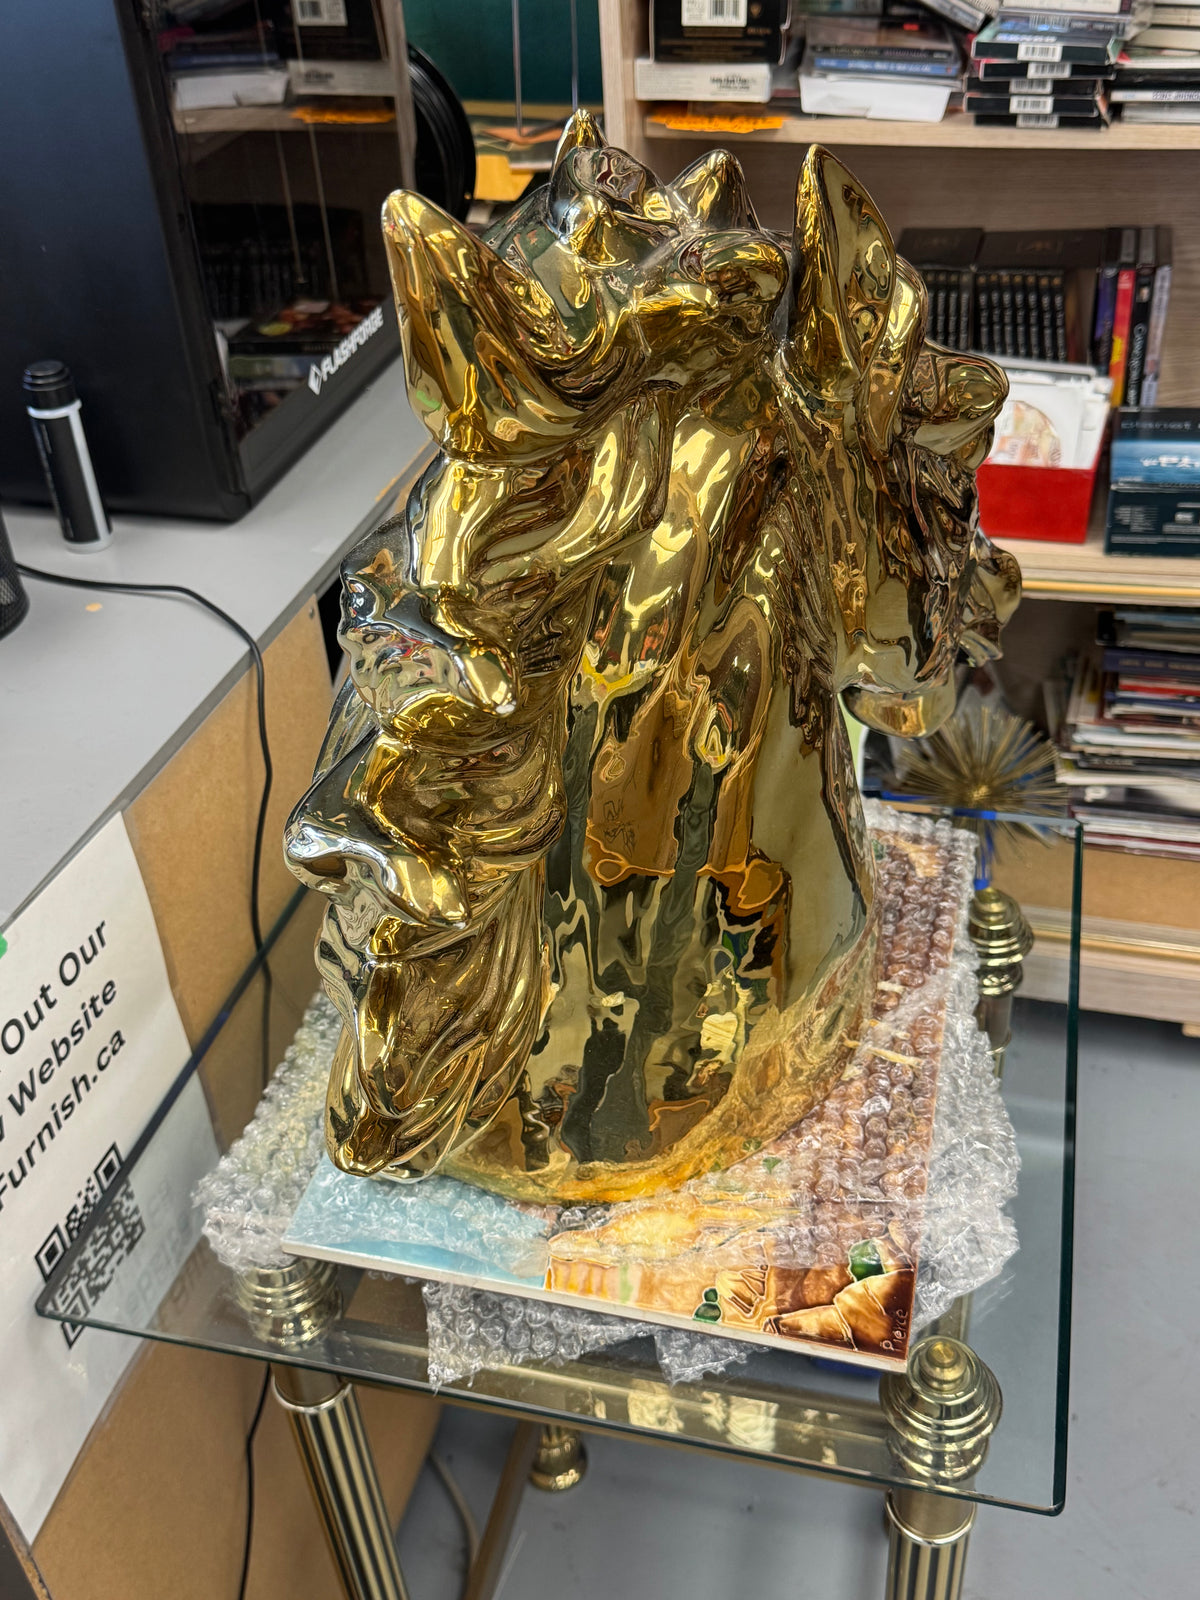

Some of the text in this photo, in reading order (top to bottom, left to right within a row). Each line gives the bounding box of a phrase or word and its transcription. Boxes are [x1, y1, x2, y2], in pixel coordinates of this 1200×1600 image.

[321, 305, 384, 382] FLASHFORGE
[1, 920, 106, 1055] Out Our
[8, 980, 117, 1117] Website
